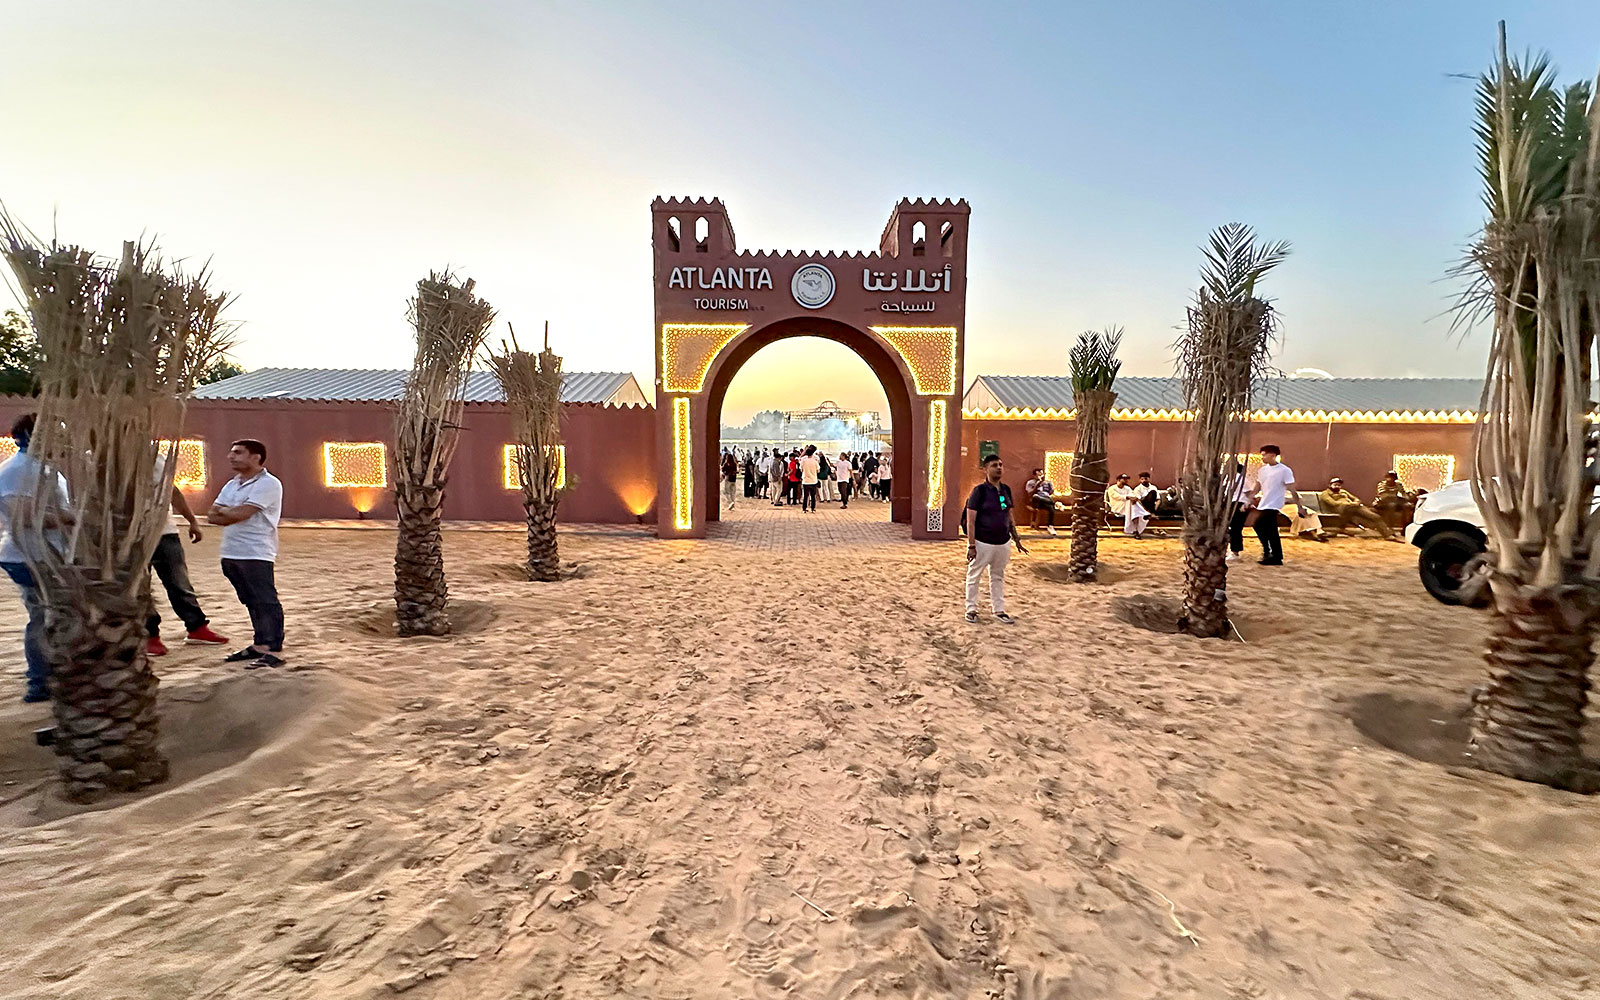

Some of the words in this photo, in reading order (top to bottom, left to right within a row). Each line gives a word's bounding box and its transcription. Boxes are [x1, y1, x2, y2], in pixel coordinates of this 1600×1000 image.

[669, 267, 773, 289] ATLANTA
[863, 264, 952, 292] أتلانتا
[694, 299, 749, 310] TOURISM
[881, 300, 936, 315] للسياحة
